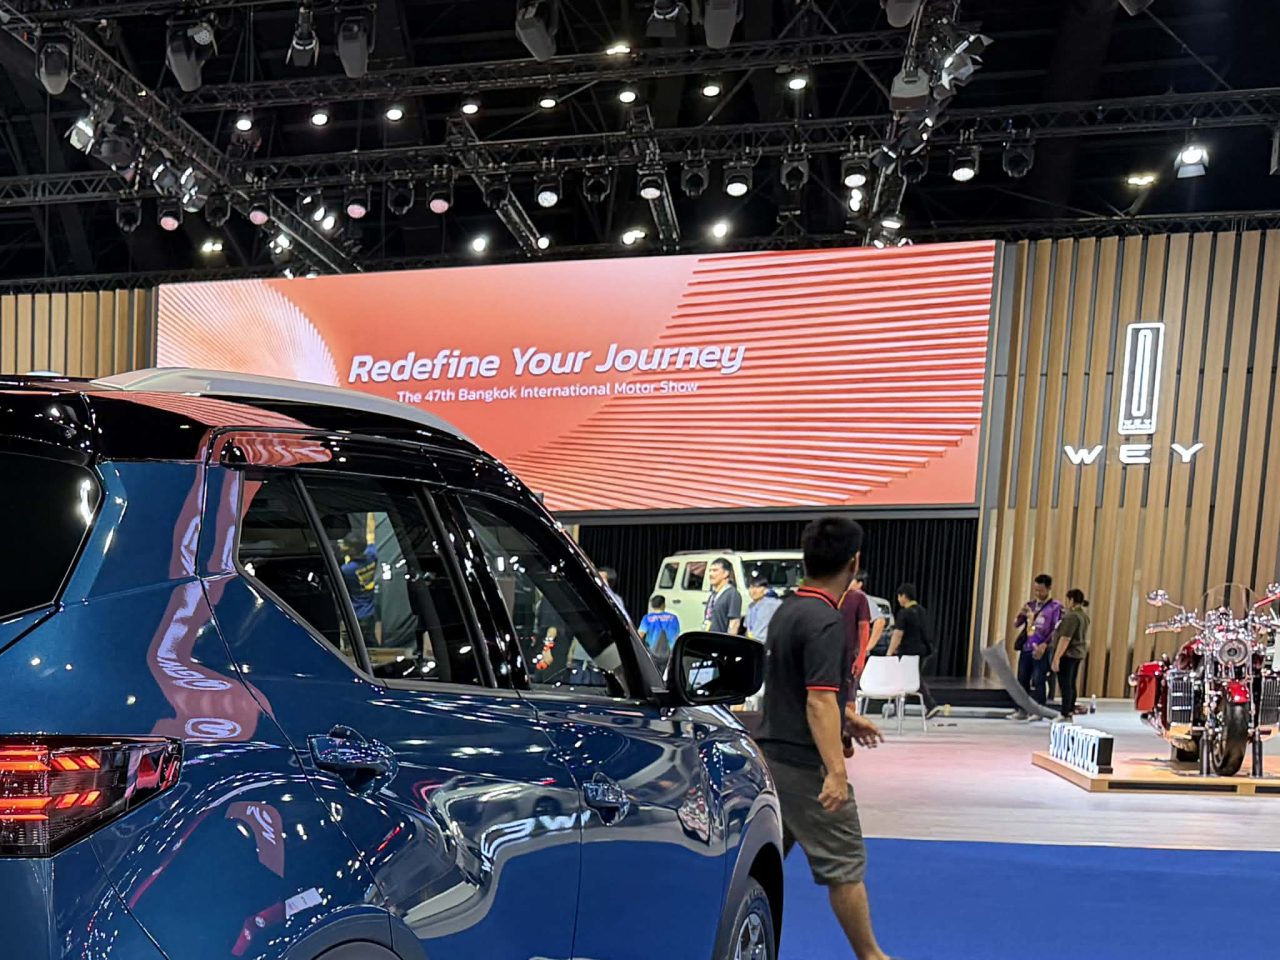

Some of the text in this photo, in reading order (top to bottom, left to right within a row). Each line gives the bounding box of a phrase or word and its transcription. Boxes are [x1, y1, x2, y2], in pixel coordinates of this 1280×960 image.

[348, 344, 746, 383] Redefine Your Journey
[397, 380, 699, 404] The 47th Bangkok International Motor Show
[1064, 443, 1204, 464] WEY
